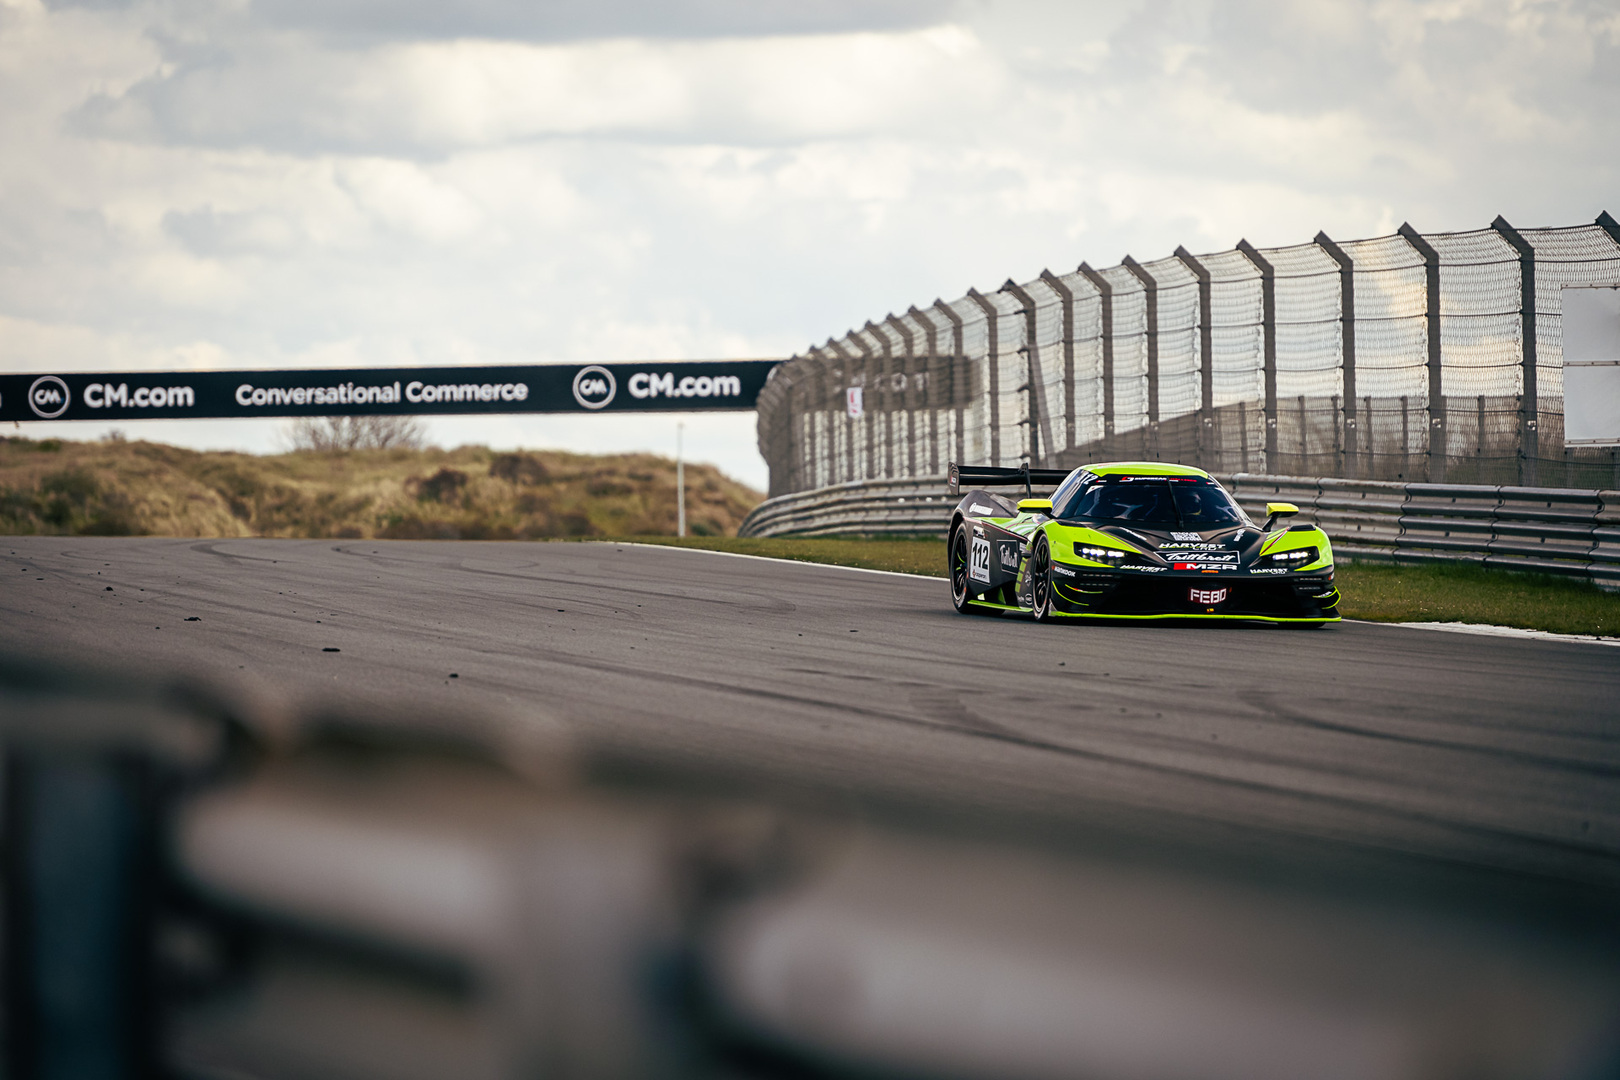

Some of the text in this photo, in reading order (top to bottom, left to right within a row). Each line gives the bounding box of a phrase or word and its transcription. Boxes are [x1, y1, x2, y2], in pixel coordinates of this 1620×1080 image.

[83, 382, 195, 409] CM.com
[235, 381, 529, 406] Conversational Commerce
[628, 371, 741, 399] CM.com
[972, 542, 989, 571] 112
[1190, 588, 1227, 604] FEBO
